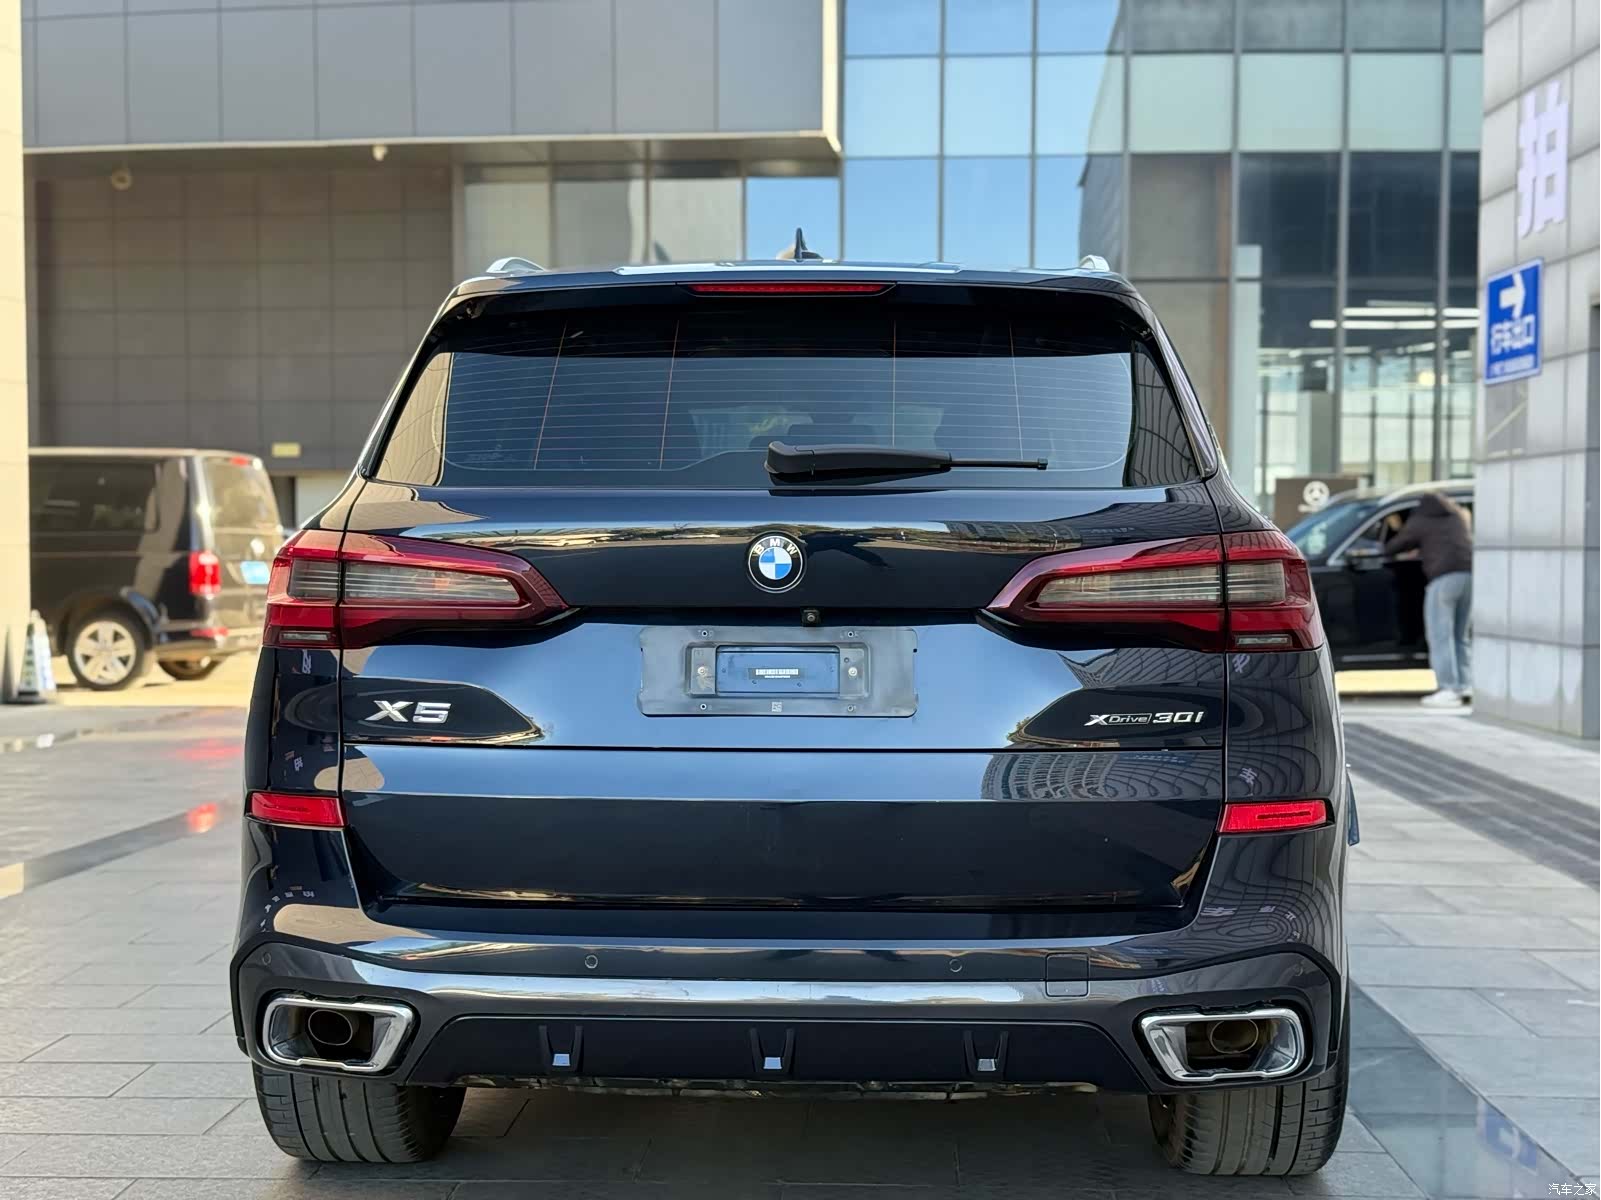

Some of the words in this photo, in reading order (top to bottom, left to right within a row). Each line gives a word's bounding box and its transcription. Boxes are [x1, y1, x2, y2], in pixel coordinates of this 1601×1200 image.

[1517, 80, 1568, 240] 拍
[752, 538, 798, 556] BMW
[364, 700, 452, 723] X5
